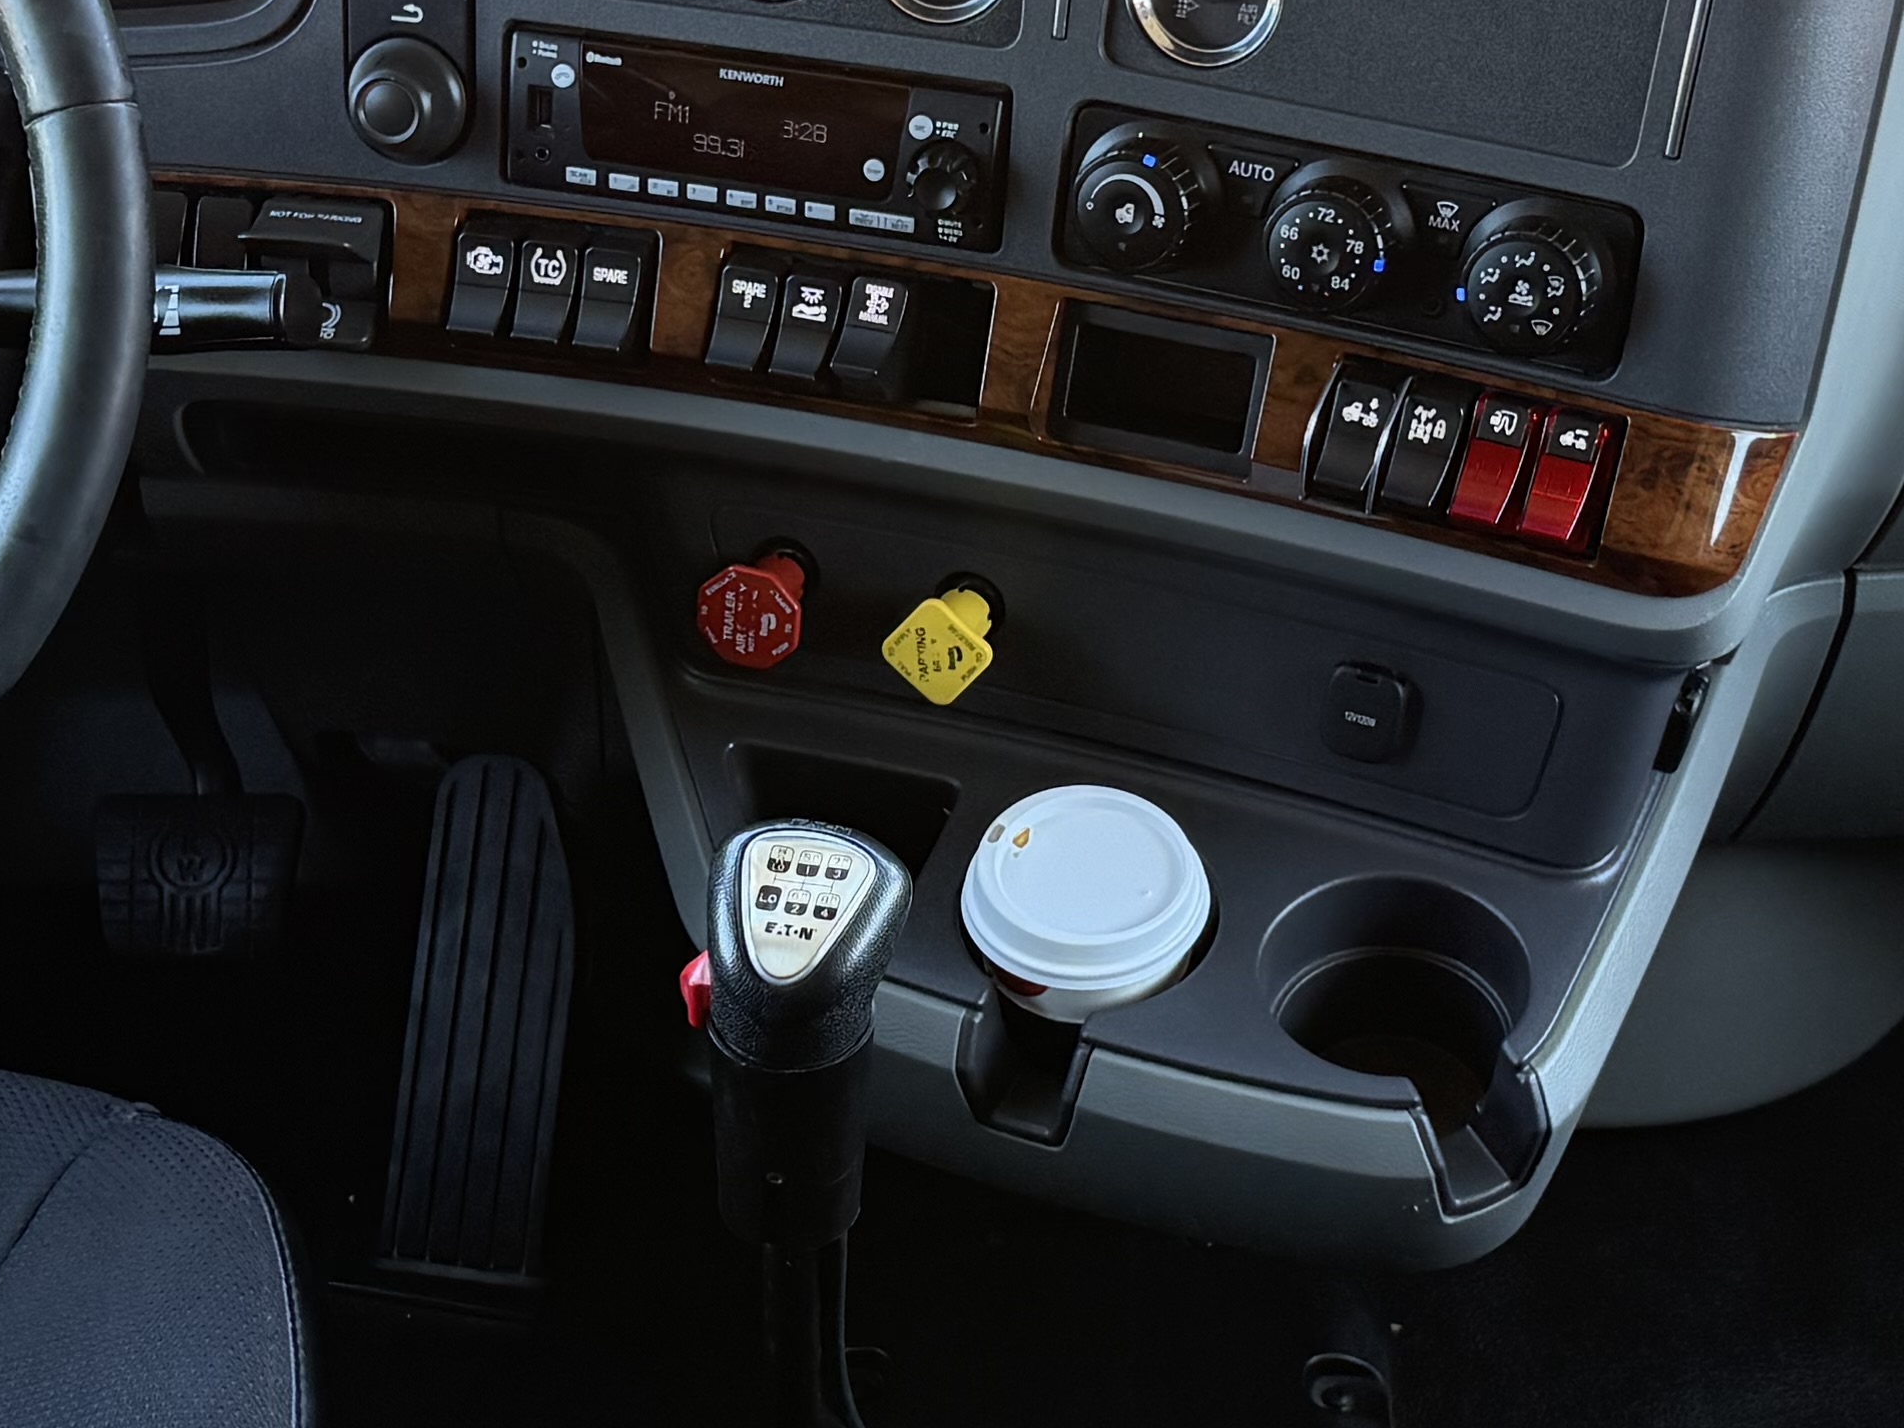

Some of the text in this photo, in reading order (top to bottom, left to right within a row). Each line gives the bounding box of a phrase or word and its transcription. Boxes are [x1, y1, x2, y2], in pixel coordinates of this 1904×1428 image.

[1239, 2, 1259, 14] AIR
[719, 67, 785, 88] KENWORTH
[653, 100, 690, 124] FM1
[782, 119, 828, 144] 3:28
[1227, 158, 1276, 183] AUTO
[269, 209, 291, 219] NOT
[317, 213, 363, 224] PARKING
[1317, 206, 1336, 224] 72
[1428, 215, 1461, 232] MAX
[1279, 225, 1299, 242] 66
[1345, 239, 1365, 255] 78
[537, 257, 560, 278] TC
[592, 265, 629, 285] SPARE
[1281, 265, 1301, 281] 60
[731, 278, 768, 300] SPARE
[1330, 275, 1351, 292] 84
[742, 297, 753, 309] 2
[723, 590, 737, 640] TRAILER
[736, 632, 747, 655] AIR
[759, 892, 778, 904] LO
[790, 904, 800, 914] 2
